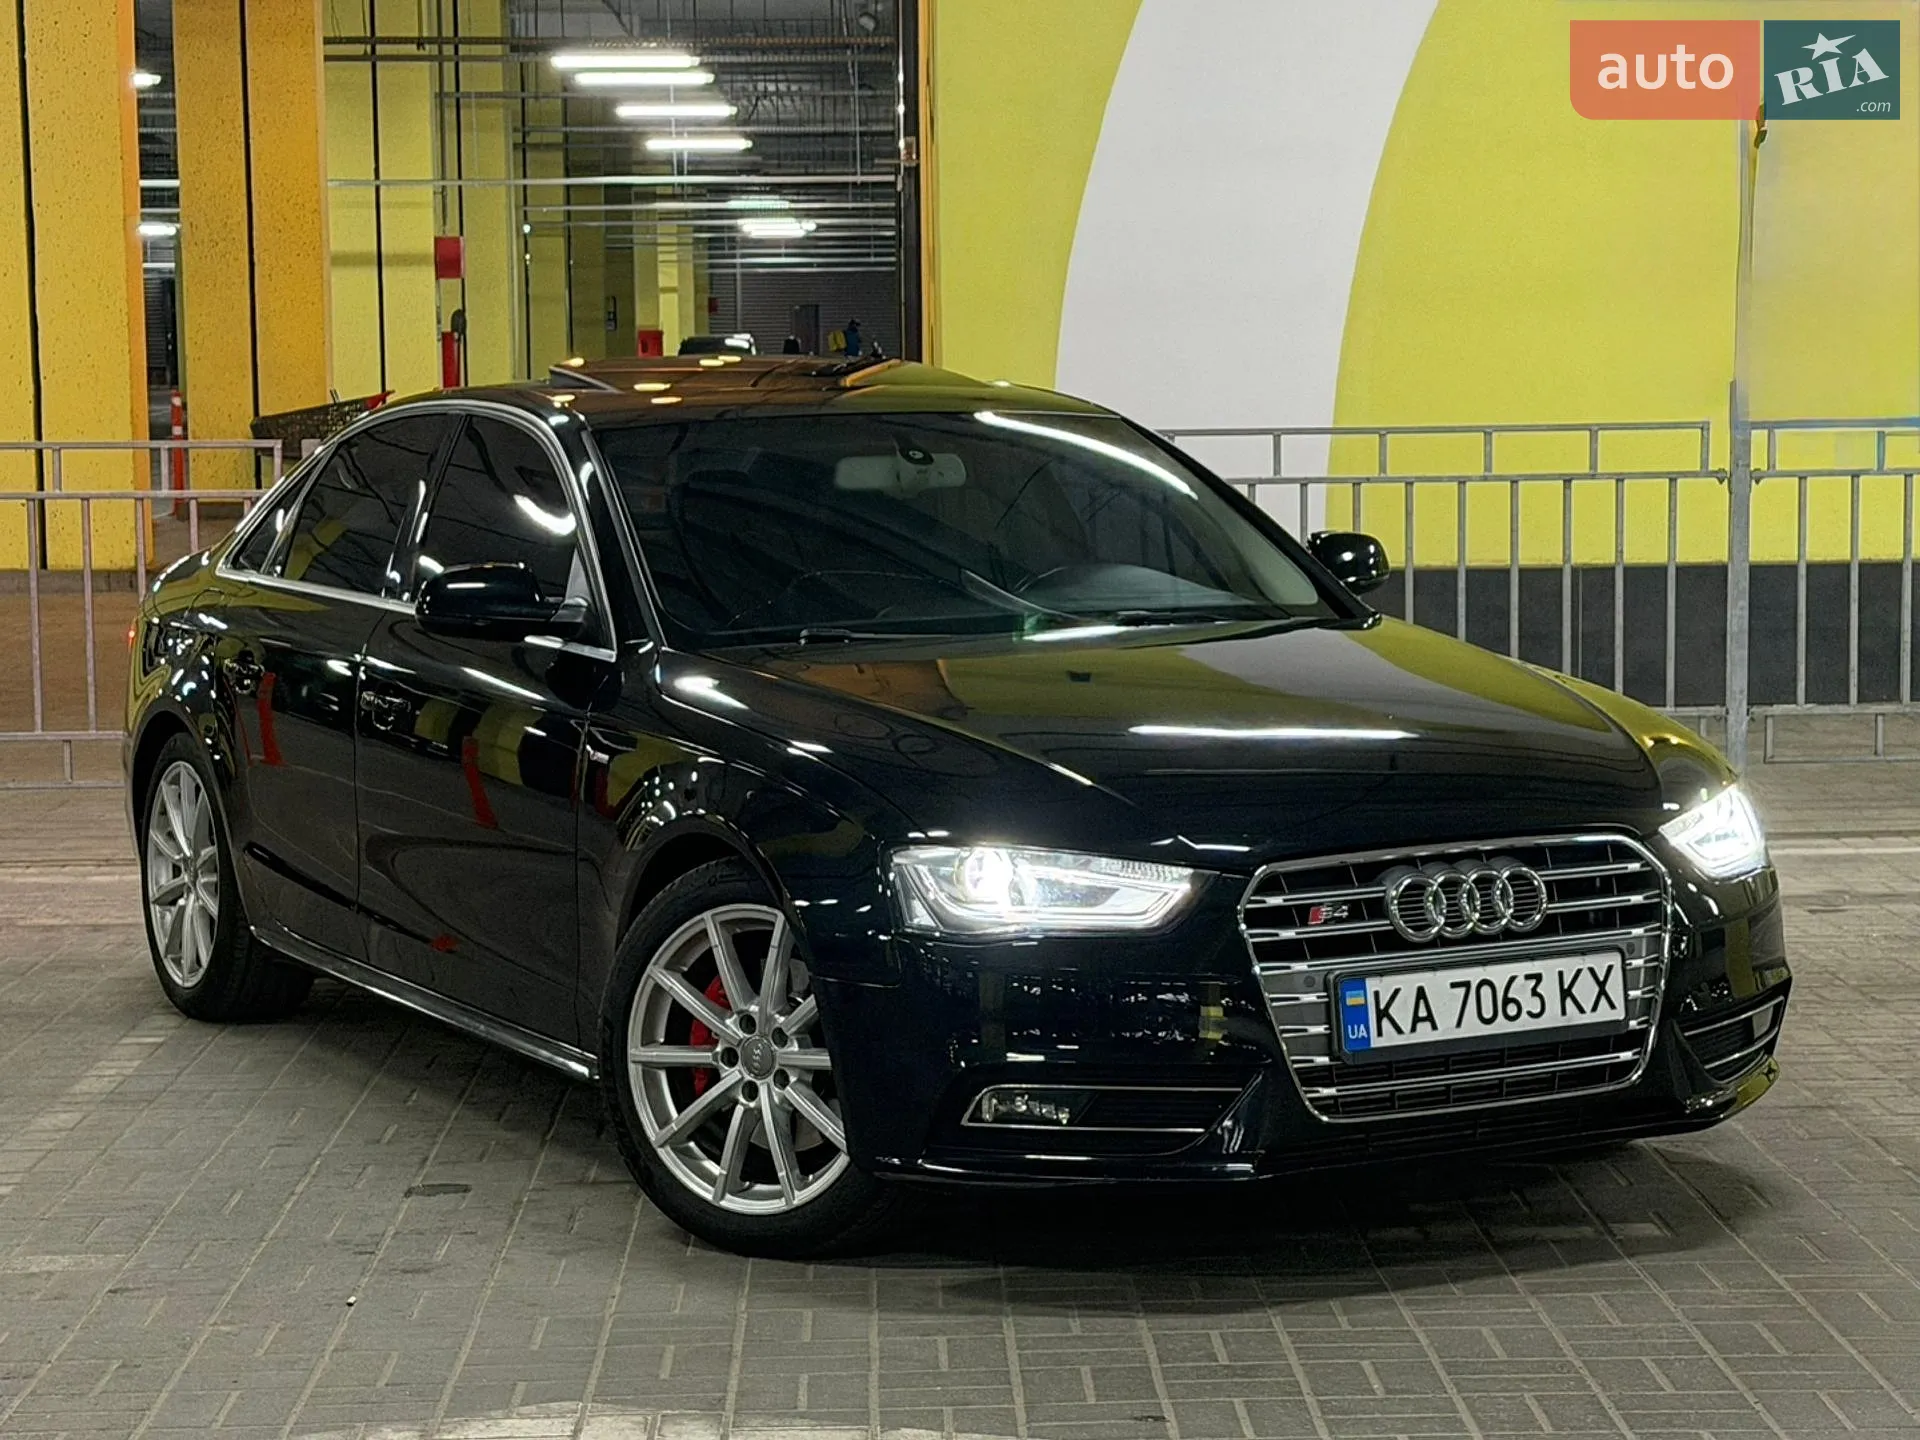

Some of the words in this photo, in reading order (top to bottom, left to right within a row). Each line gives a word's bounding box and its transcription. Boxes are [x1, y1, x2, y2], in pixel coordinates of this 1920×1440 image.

[1373, 985, 1439, 1038] KA
[1450, 973, 1546, 1029] 7063
[1557, 964, 1617, 1016] KX
[1348, 1022, 1368, 1040] UA
